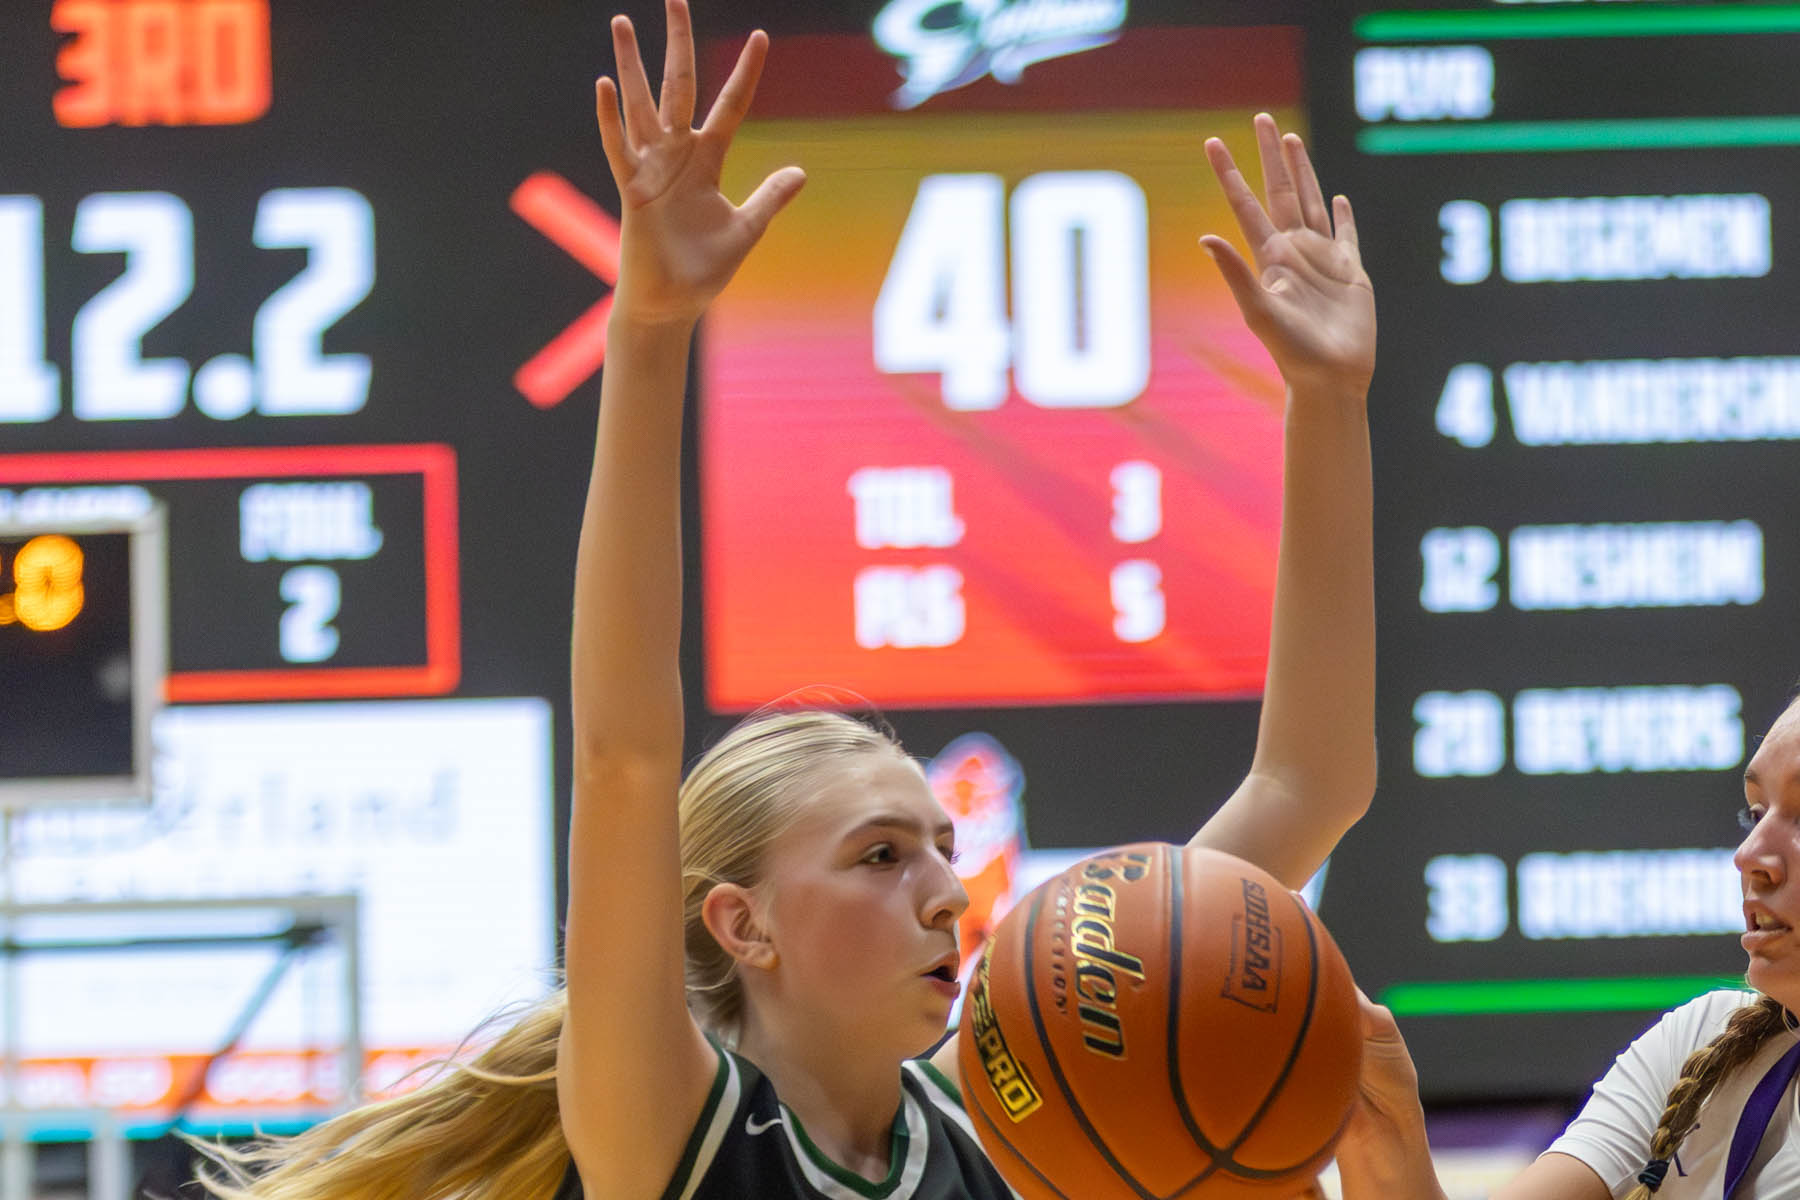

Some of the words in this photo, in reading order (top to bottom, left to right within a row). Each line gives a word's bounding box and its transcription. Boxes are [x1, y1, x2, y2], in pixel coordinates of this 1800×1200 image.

[52, 0, 272, 127] 3RD
[1439, 203, 1491, 284] 3
[873, 172, 1151, 411] 40
[1437, 365, 1495, 446] 4
[1111, 463, 1161, 542] 3
[1111, 561, 1164, 641] 5
[1421, 528, 1500, 611] 12
[280, 567, 340, 661] 2
[1070, 853, 1153, 1061] Baden
[978, 1027, 1036, 1114] PRO
